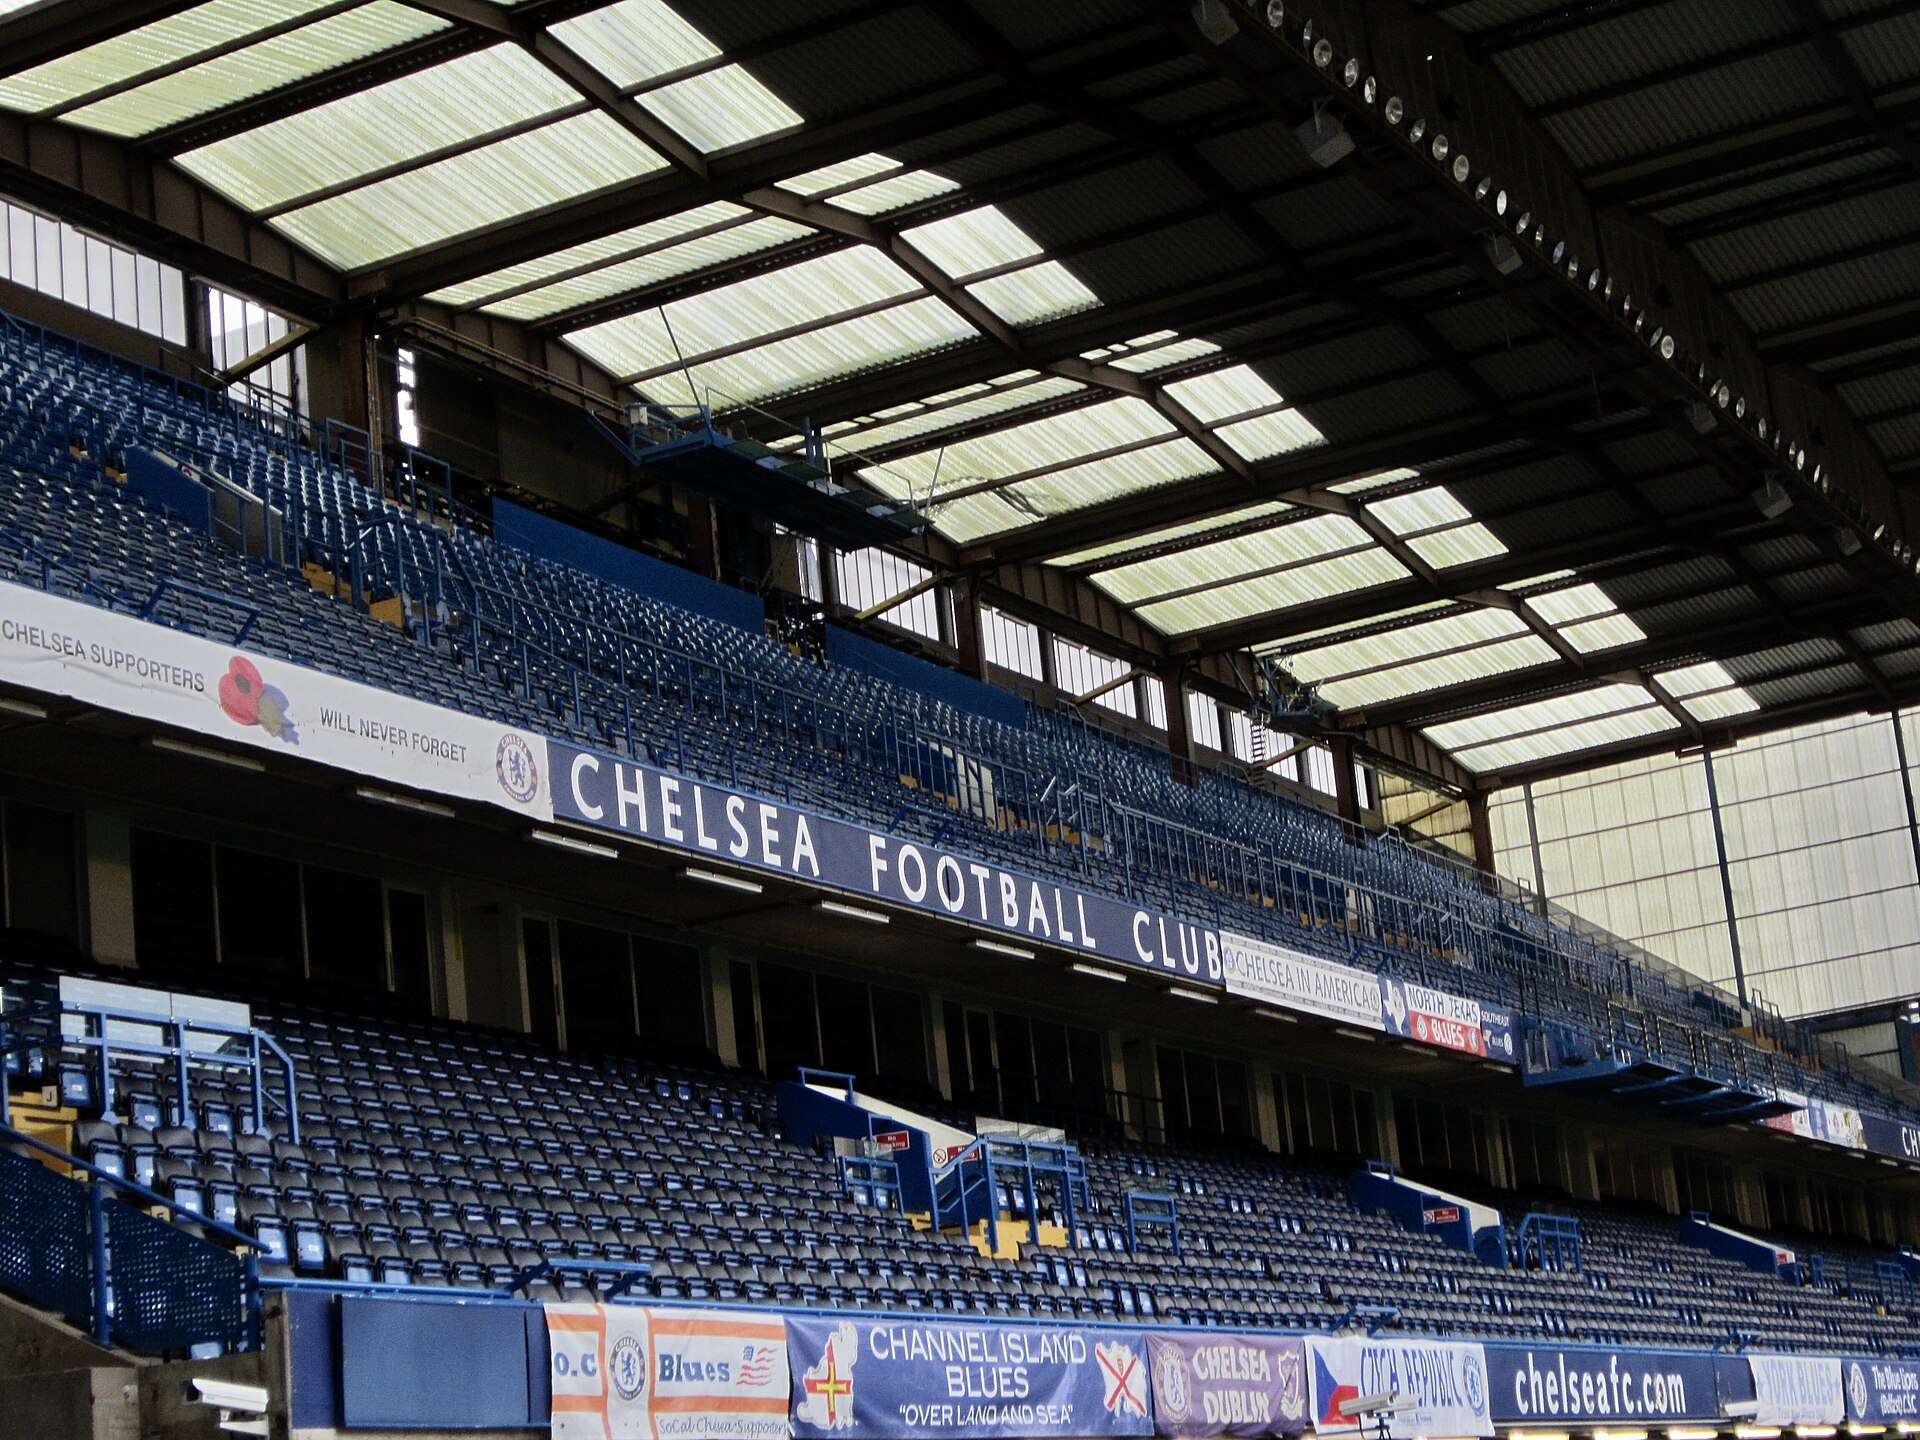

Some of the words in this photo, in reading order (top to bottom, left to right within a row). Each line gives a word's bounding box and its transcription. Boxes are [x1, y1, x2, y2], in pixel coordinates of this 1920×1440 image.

[2, 620, 86, 659] CHELSEA
[90, 643, 205, 692] SUPPORTERS
[320, 707, 355, 734] WILL
[360, 718, 408, 747] NEVER
[412, 732, 467, 763] FORGET
[502, 735, 527, 755] CHELSEA
[571, 752, 820, 877] CHELSEA
[869, 834, 1096, 949] FOOTBALL
[1133, 910, 1221, 980] CLUB
[1236, 950, 1295, 990] CHELSEA
[1296, 966, 1311, 994] IN
[1315, 972, 1371, 1010] AMERICA
[1408, 985, 1445, 1015] NORTH
[1449, 997, 1478, 1024] TEXAS
[1481, 1010, 1510, 1027] SOUTHEAST
[1431, 1018, 1466, 1048] BLUES
[870, 1327, 999, 1362] CHANNEL
[1000, 1332, 1087, 1364] ISLAND
[1192, 1345, 1272, 1382] CHELSEA
[658, 1353, 730, 1382] Blues
[945, 1366, 1030, 1398] BLUES
[1402, 1349, 1463, 1407] REPUBLIC
[1515, 1352, 1687, 1415] chelseafc.com
[1796, 1360, 1834, 1406] BLUES
[1871, 1364, 1886, 1390] The
[1884, 1365, 1901, 1390] Blue
[957, 1405, 998, 1426] LAND
[1001, 1405, 1034, 1425] AND
[1203, 1390, 1272, 1424] DUBLIN
[660, 1417, 695, 1435] SoCal
